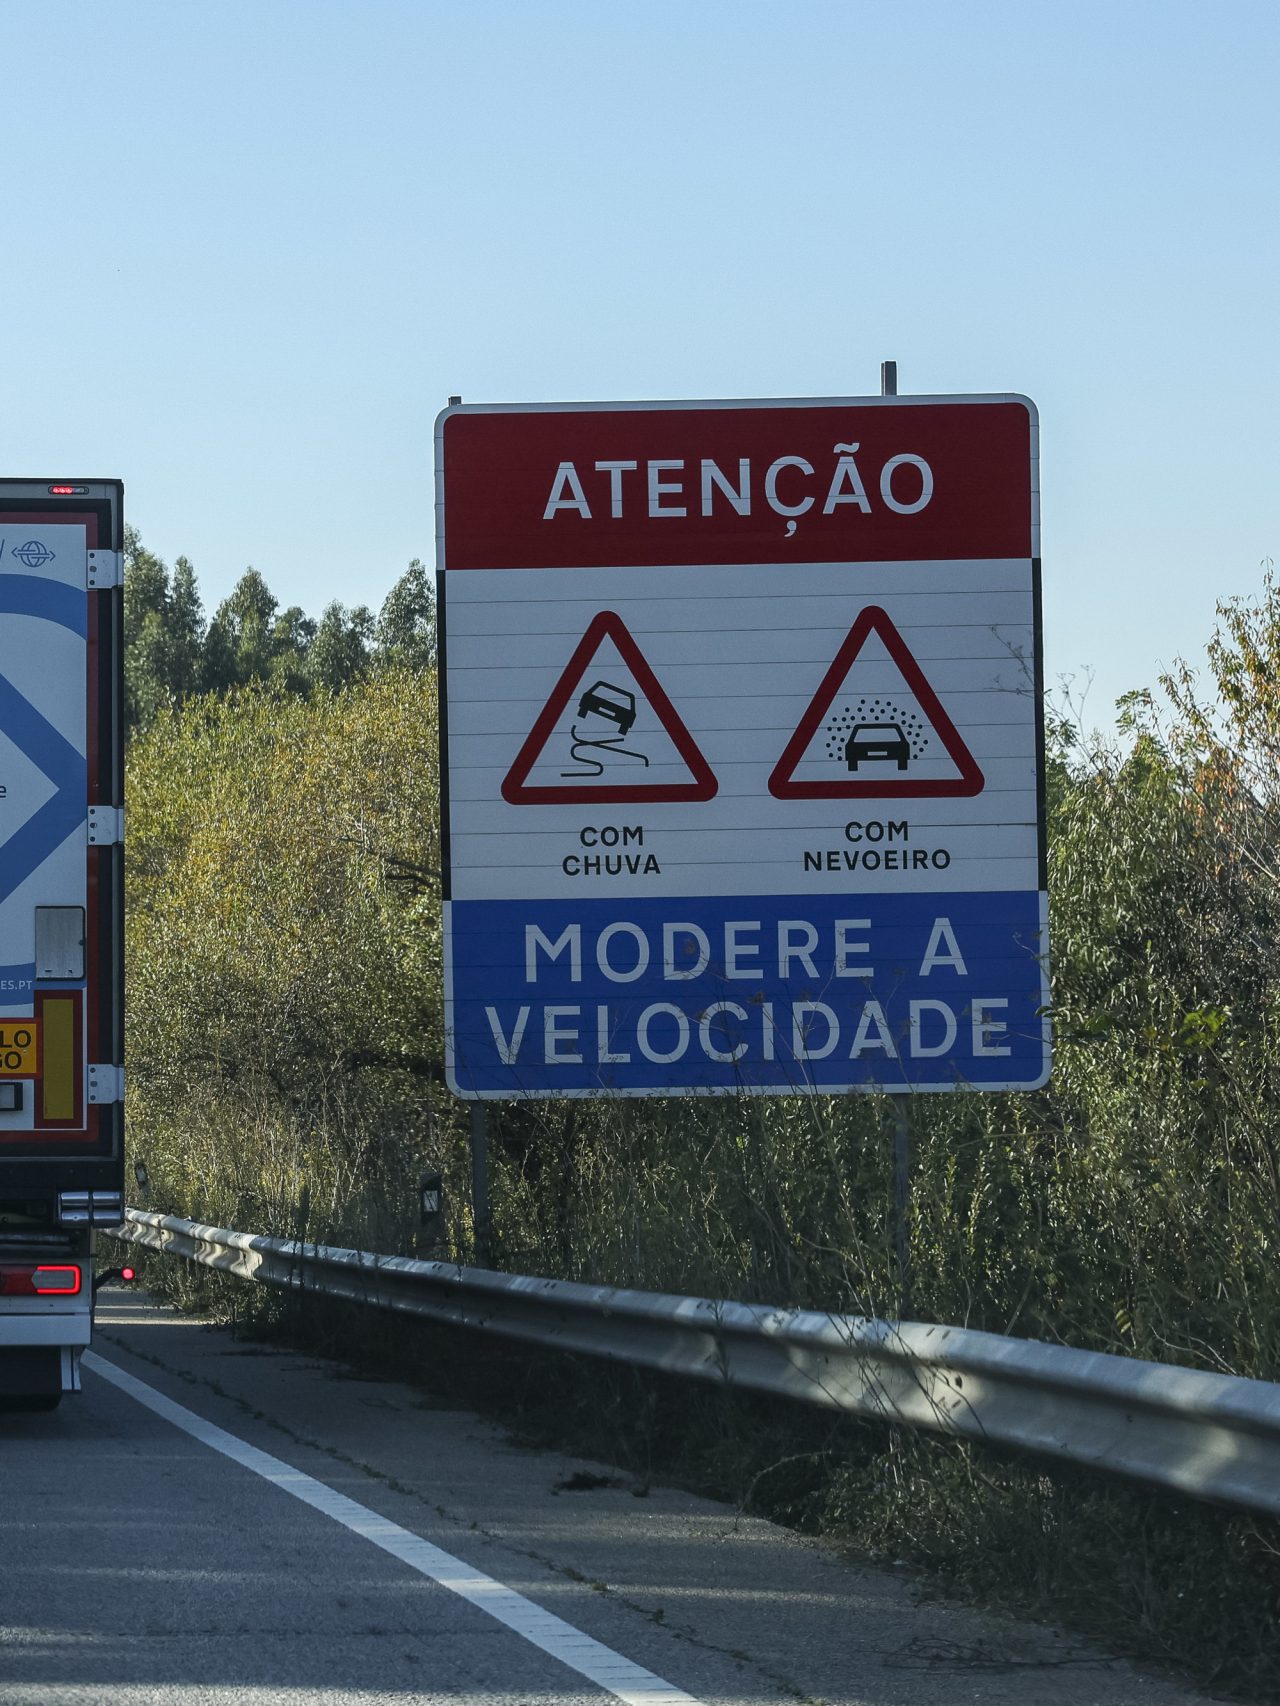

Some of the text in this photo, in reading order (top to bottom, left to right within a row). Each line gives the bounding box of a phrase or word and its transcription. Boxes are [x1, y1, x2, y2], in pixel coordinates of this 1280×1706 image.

[542, 442, 934, 538] ATENÇÃO
[580, 826, 644, 847] COM
[844, 820, 909, 843] COM
[561, 854, 661, 876] CHUVA
[803, 848, 951, 872] NEVOEIRO
[524, 917, 969, 984] MODERE A
[485, 998, 1012, 1066] VELOCIDADE
